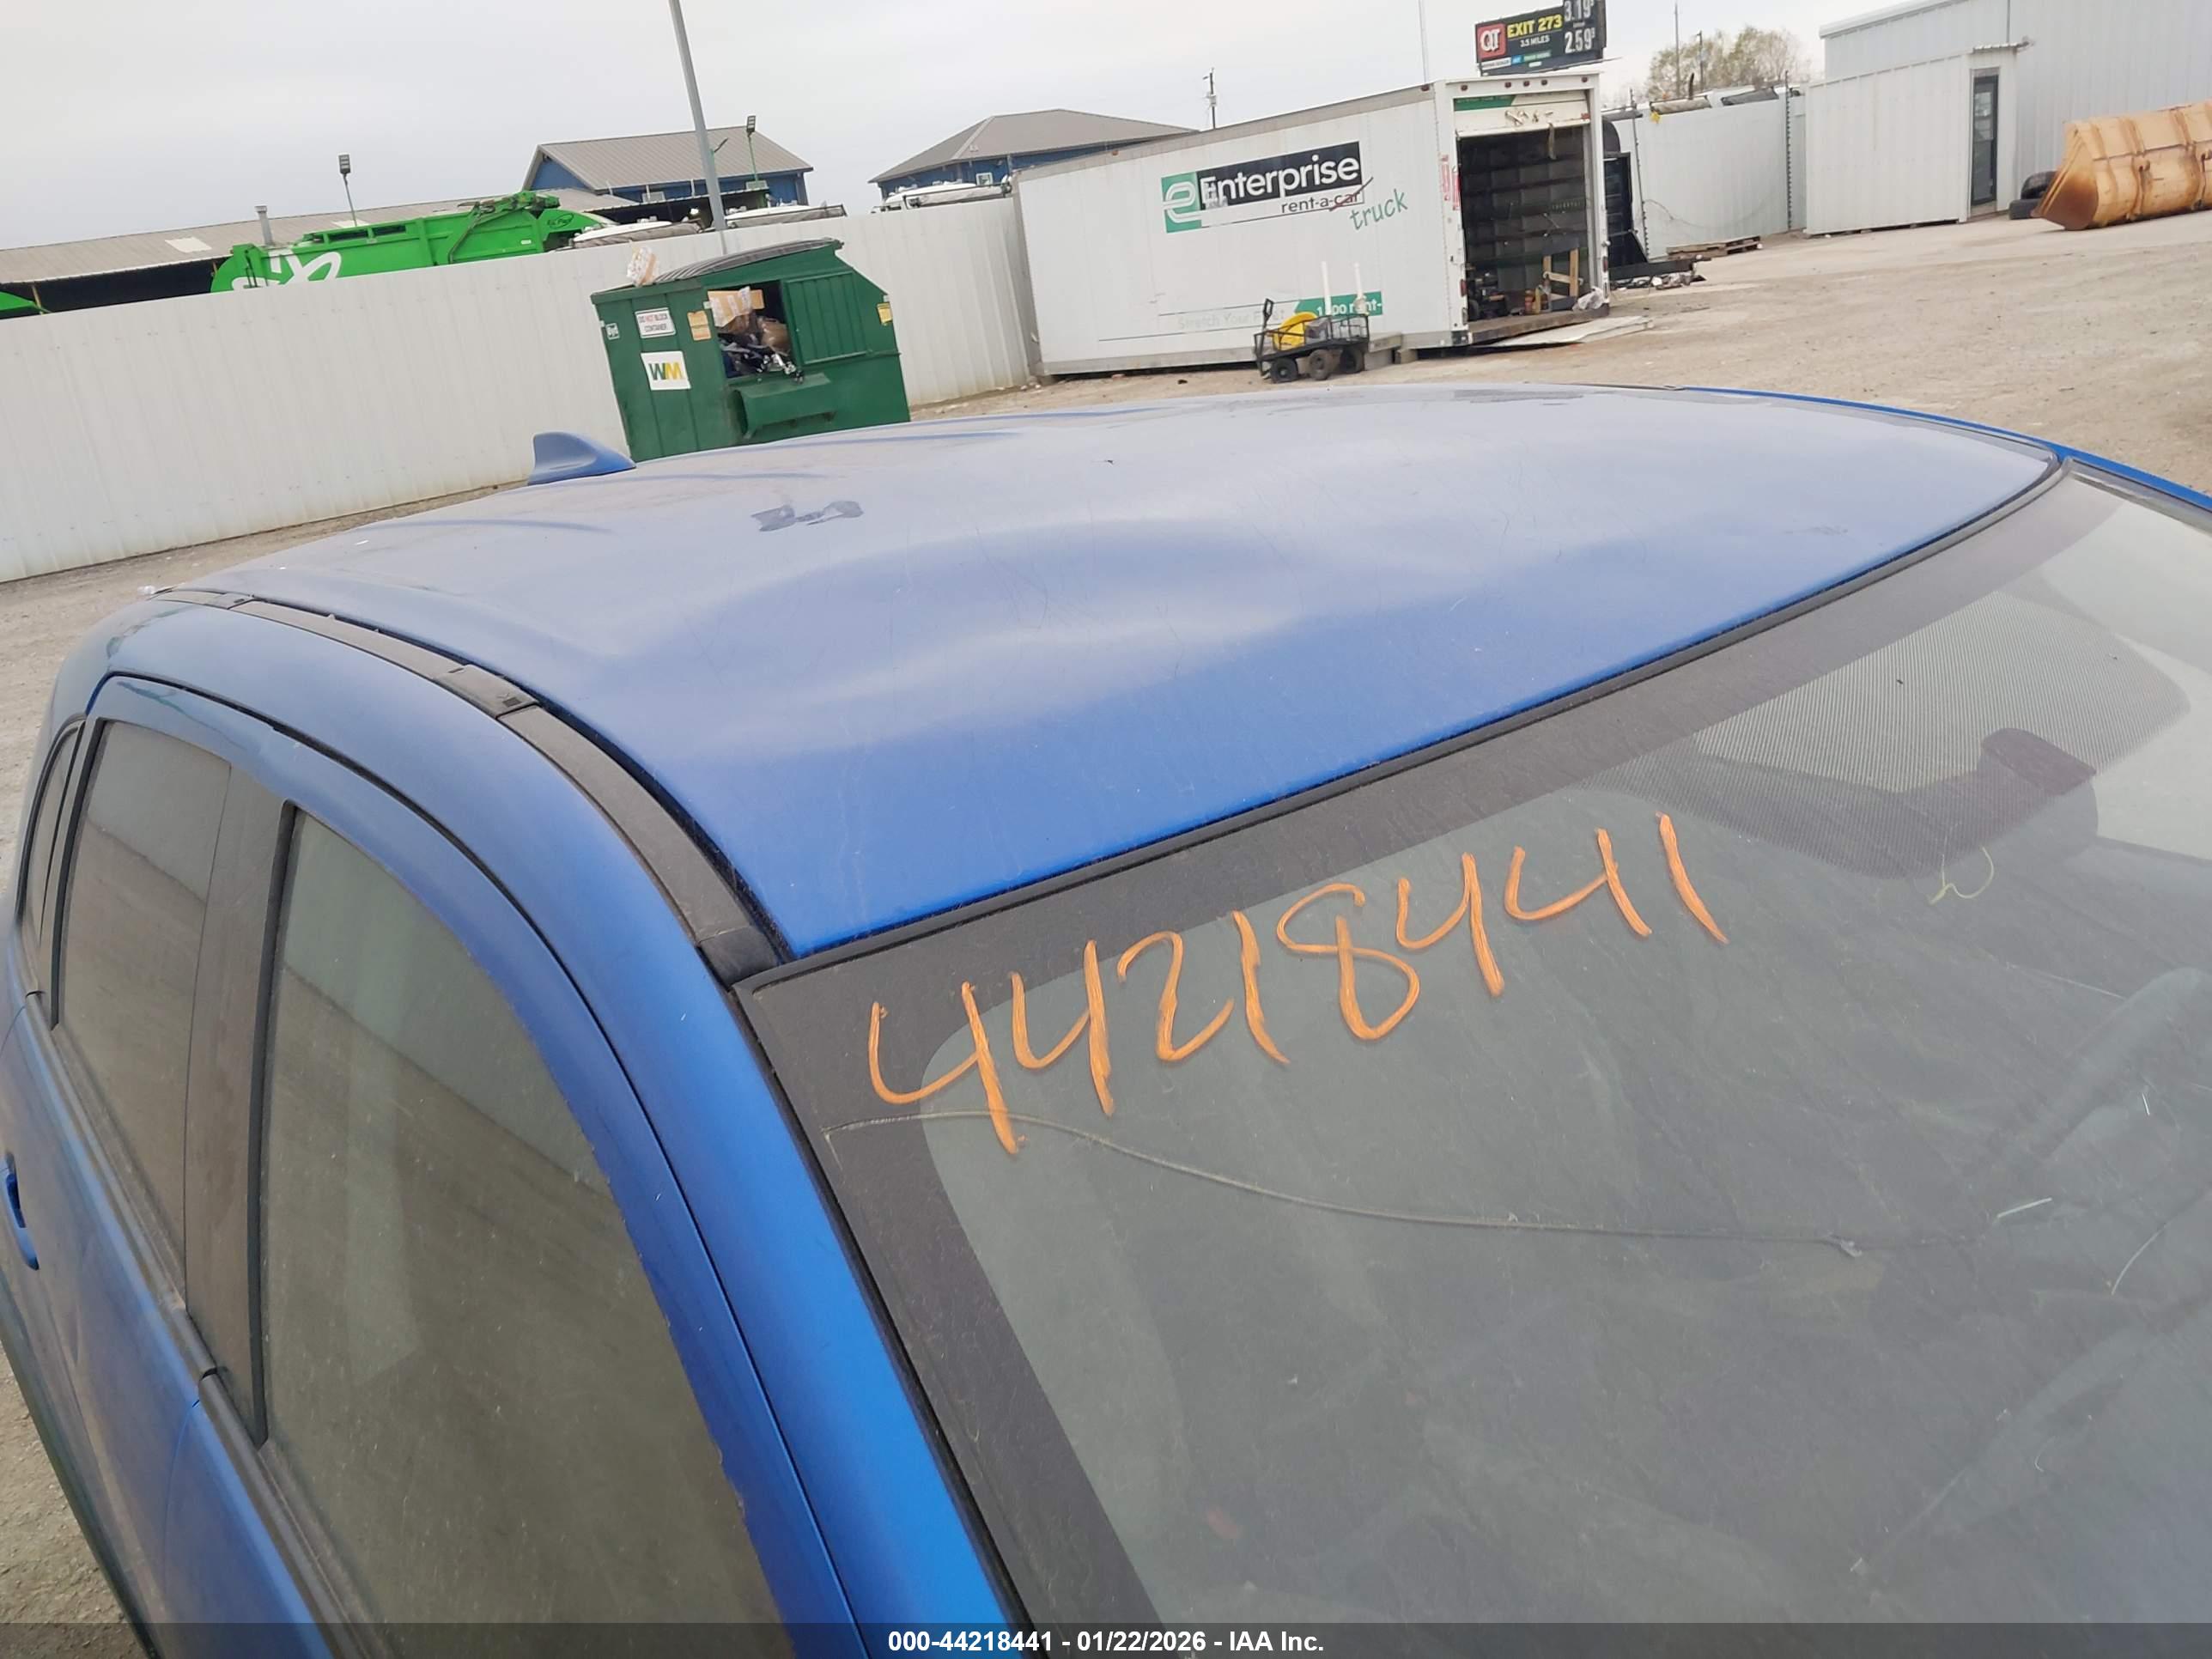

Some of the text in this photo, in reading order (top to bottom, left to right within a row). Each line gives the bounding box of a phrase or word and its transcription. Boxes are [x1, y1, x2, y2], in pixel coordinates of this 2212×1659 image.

[1507, 14, 1563, 39] EXIT 273
[1480, 27, 1501, 52] QT
[1530, 35, 1550, 46] MILES
[1200, 154, 1360, 204] Enterprise
[1281, 191, 1360, 214] rent-a-car
[1350, 188, 1408, 230] truck
[648, 362, 684, 380] WM
[868, 811, 1728, 1156] 44218441
